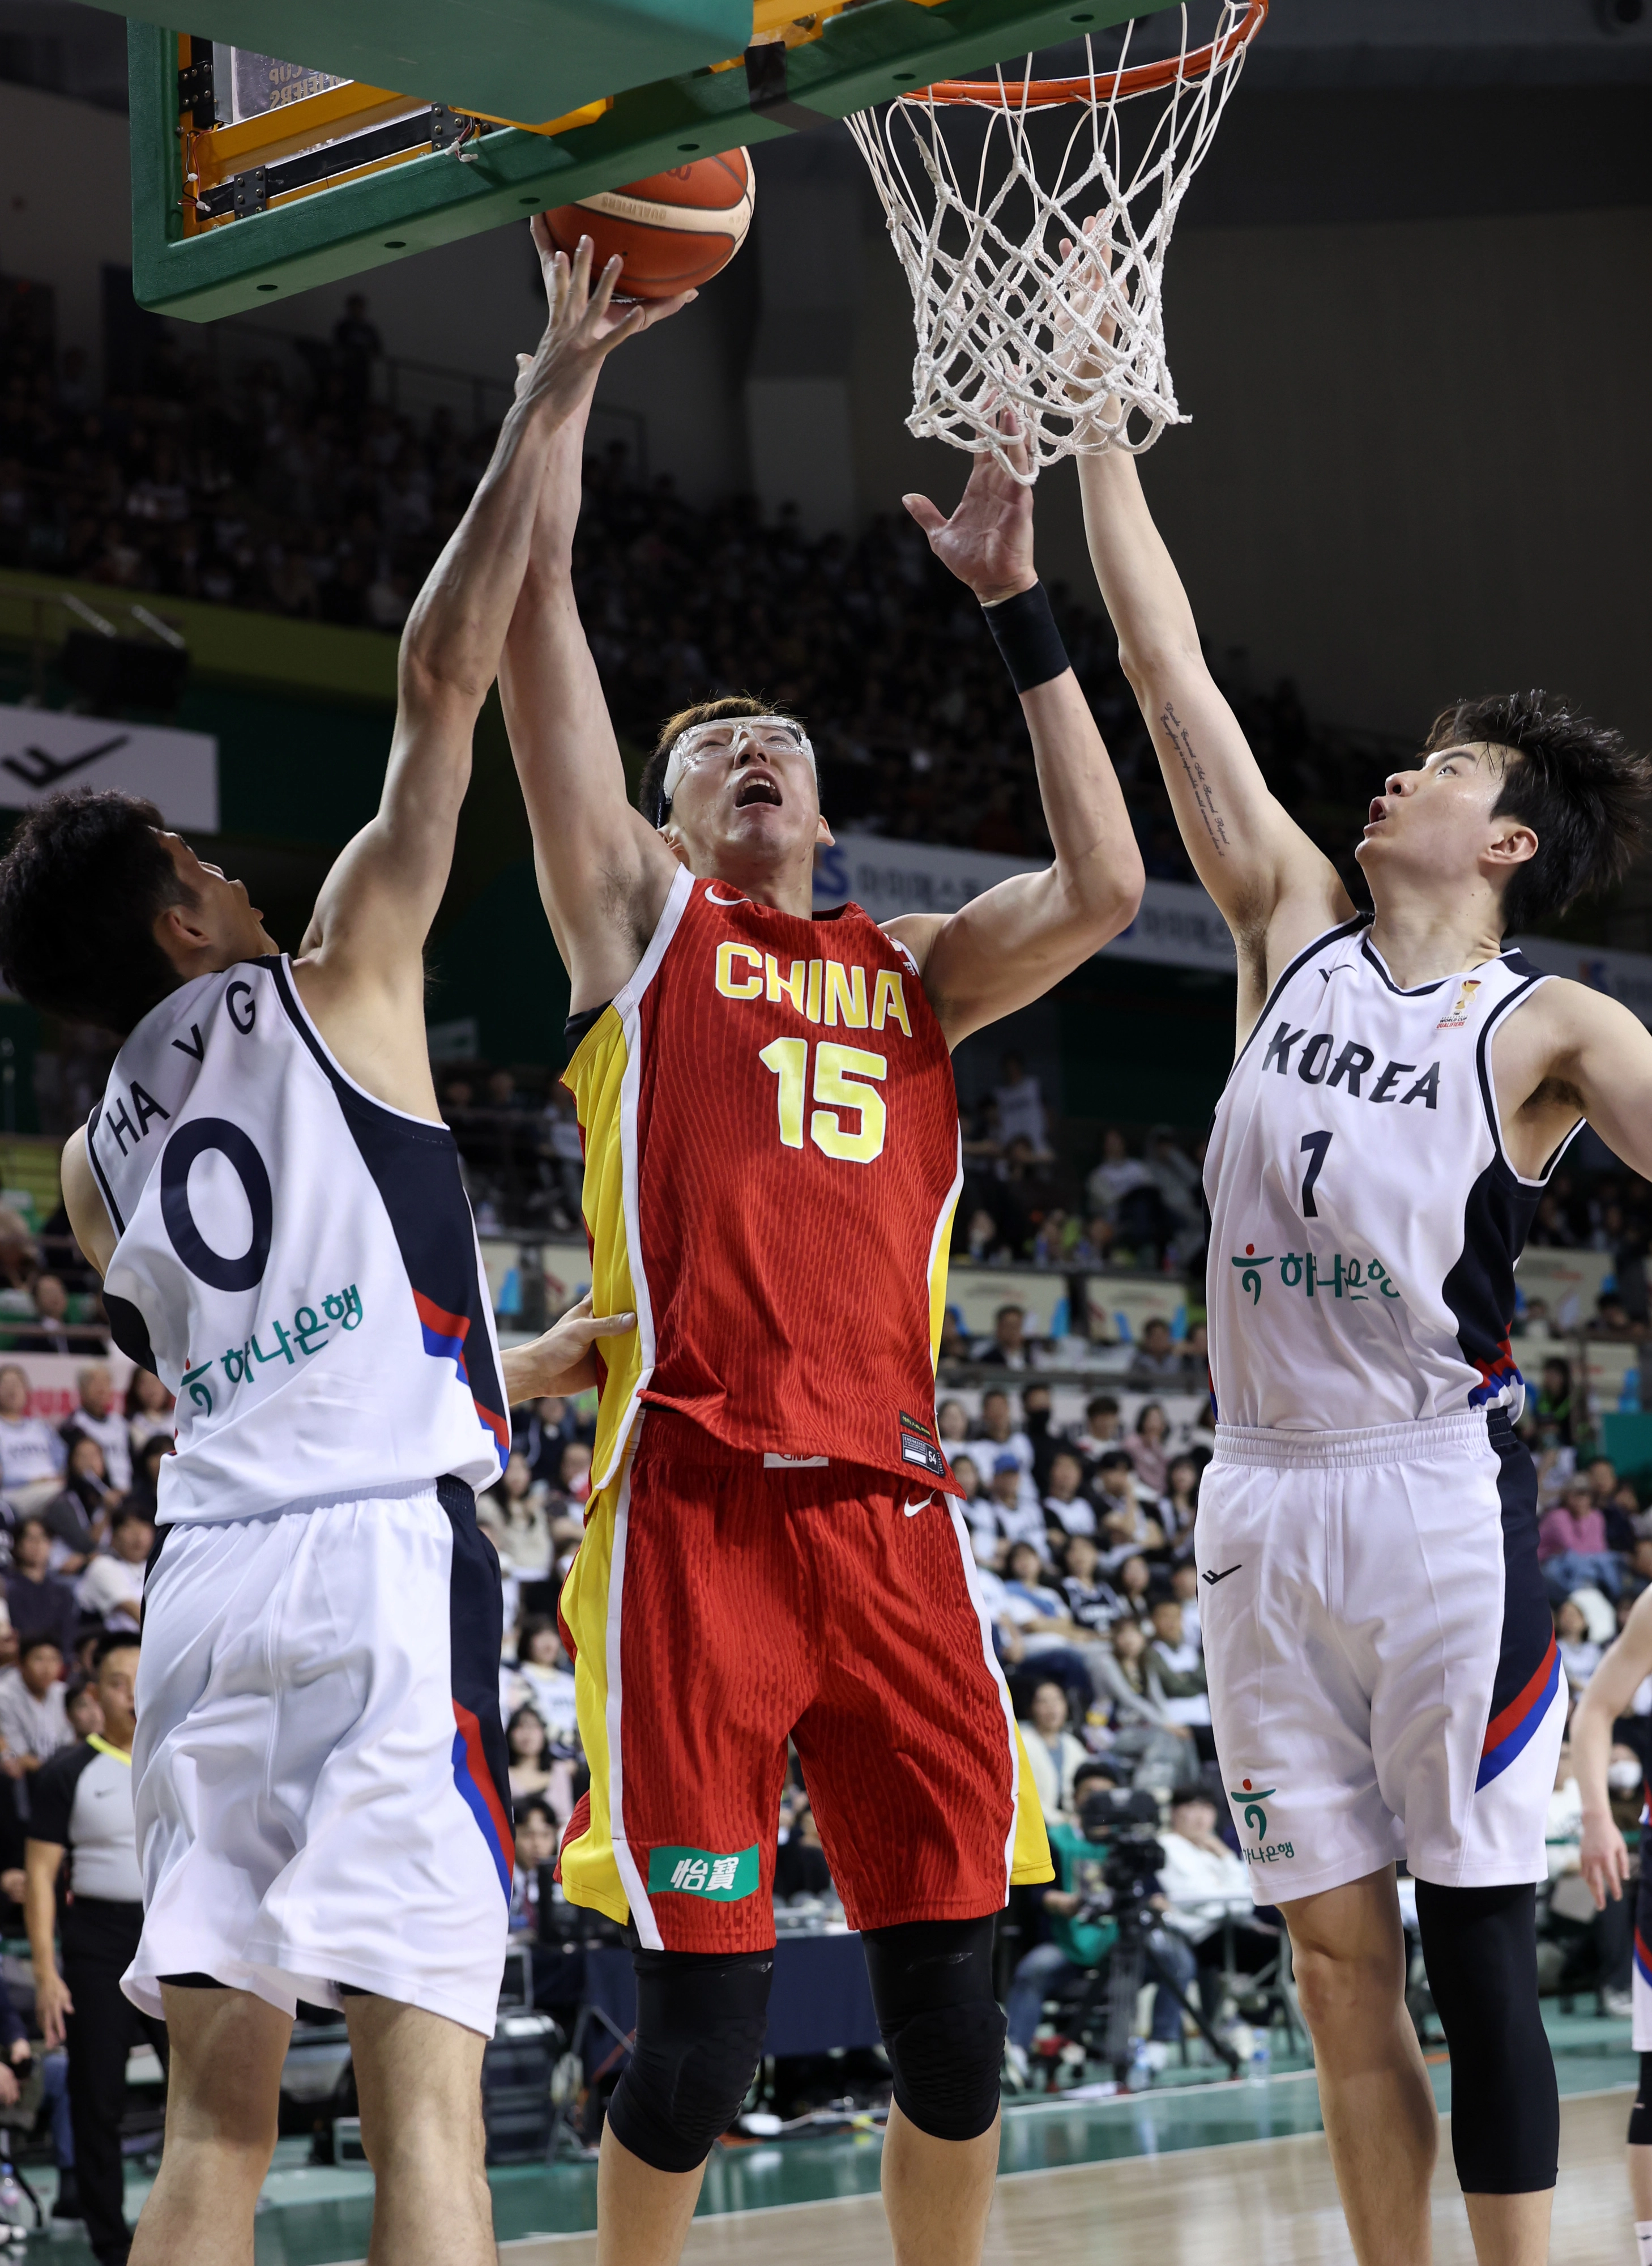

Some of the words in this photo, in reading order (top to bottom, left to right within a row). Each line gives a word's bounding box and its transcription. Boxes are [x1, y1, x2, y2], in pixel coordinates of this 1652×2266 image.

[715, 941, 912, 1038] CHINA
[106, 1080, 170, 1157] HA
[226, 981, 255, 1034] G
[759, 1037, 887, 1164] 15
[1262, 1021, 1440, 1109] KOREA
[161, 1117, 272, 1292] 0
[1300, 1130, 1333, 1217] 1
[220, 1284, 362, 1383] 하나은행
[928, 1451, 937, 1465] 54
